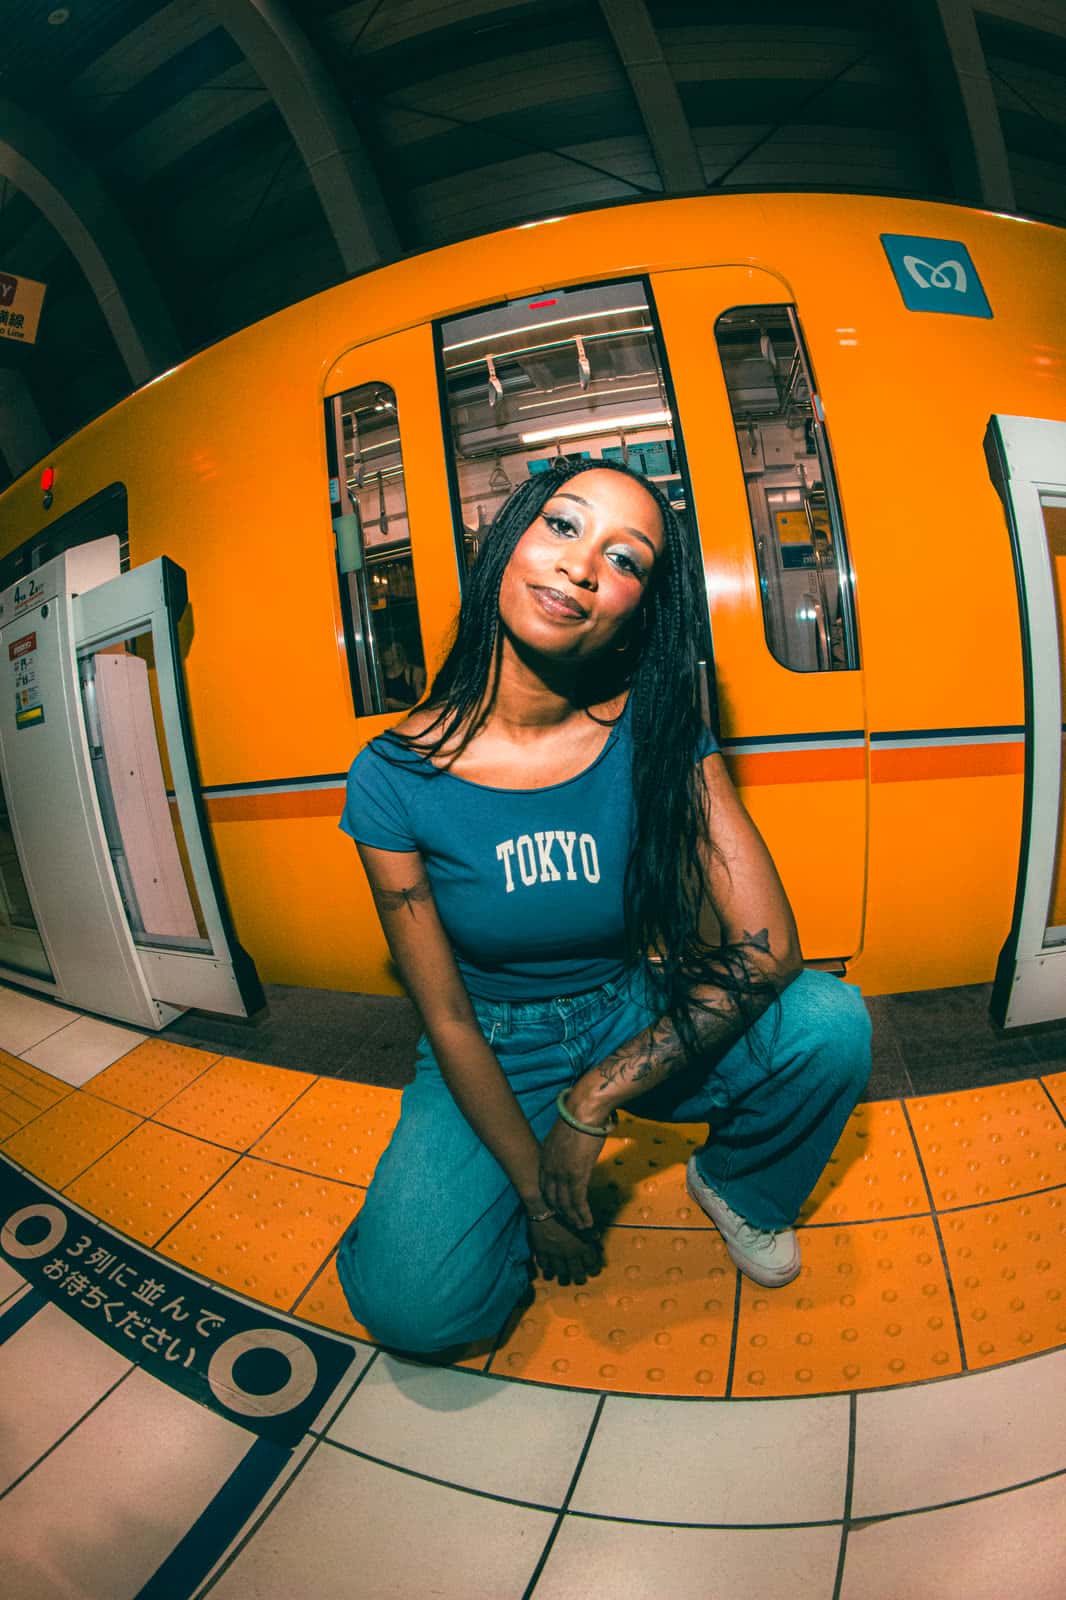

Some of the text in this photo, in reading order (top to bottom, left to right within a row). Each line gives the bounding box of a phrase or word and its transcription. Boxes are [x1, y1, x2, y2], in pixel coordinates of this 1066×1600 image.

[496, 831, 600, 893] TOKYO
[42, 1258, 196, 1368] お待ちください
[65, 1235, 226, 1337] 3列に並んで
